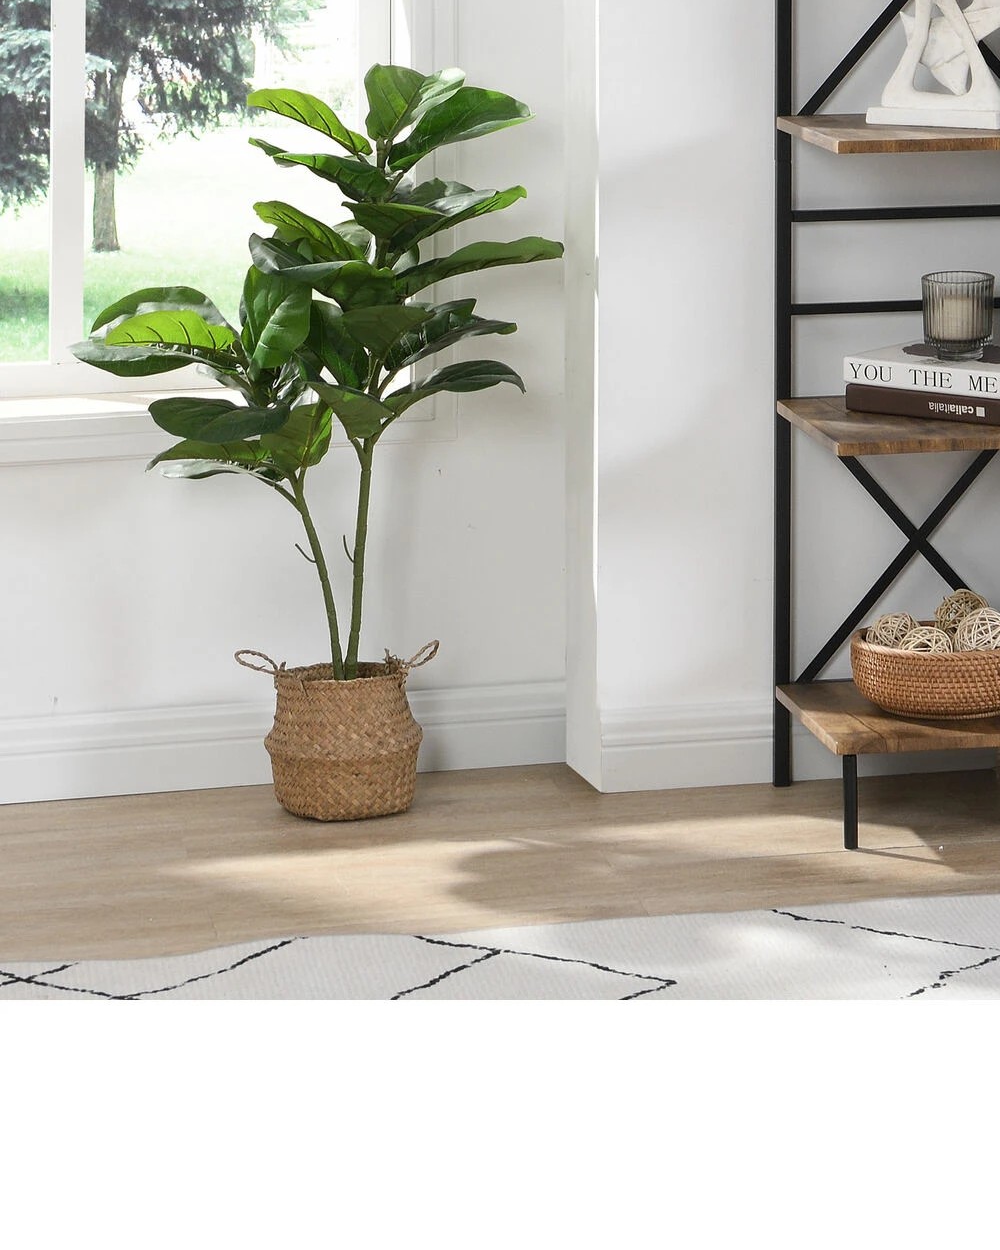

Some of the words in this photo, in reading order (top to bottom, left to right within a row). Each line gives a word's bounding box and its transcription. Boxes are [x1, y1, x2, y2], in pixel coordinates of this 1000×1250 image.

[849, 363, 892, 382] YOU
[909, 369, 952, 389] THE
[969, 375, 998, 393] ME
